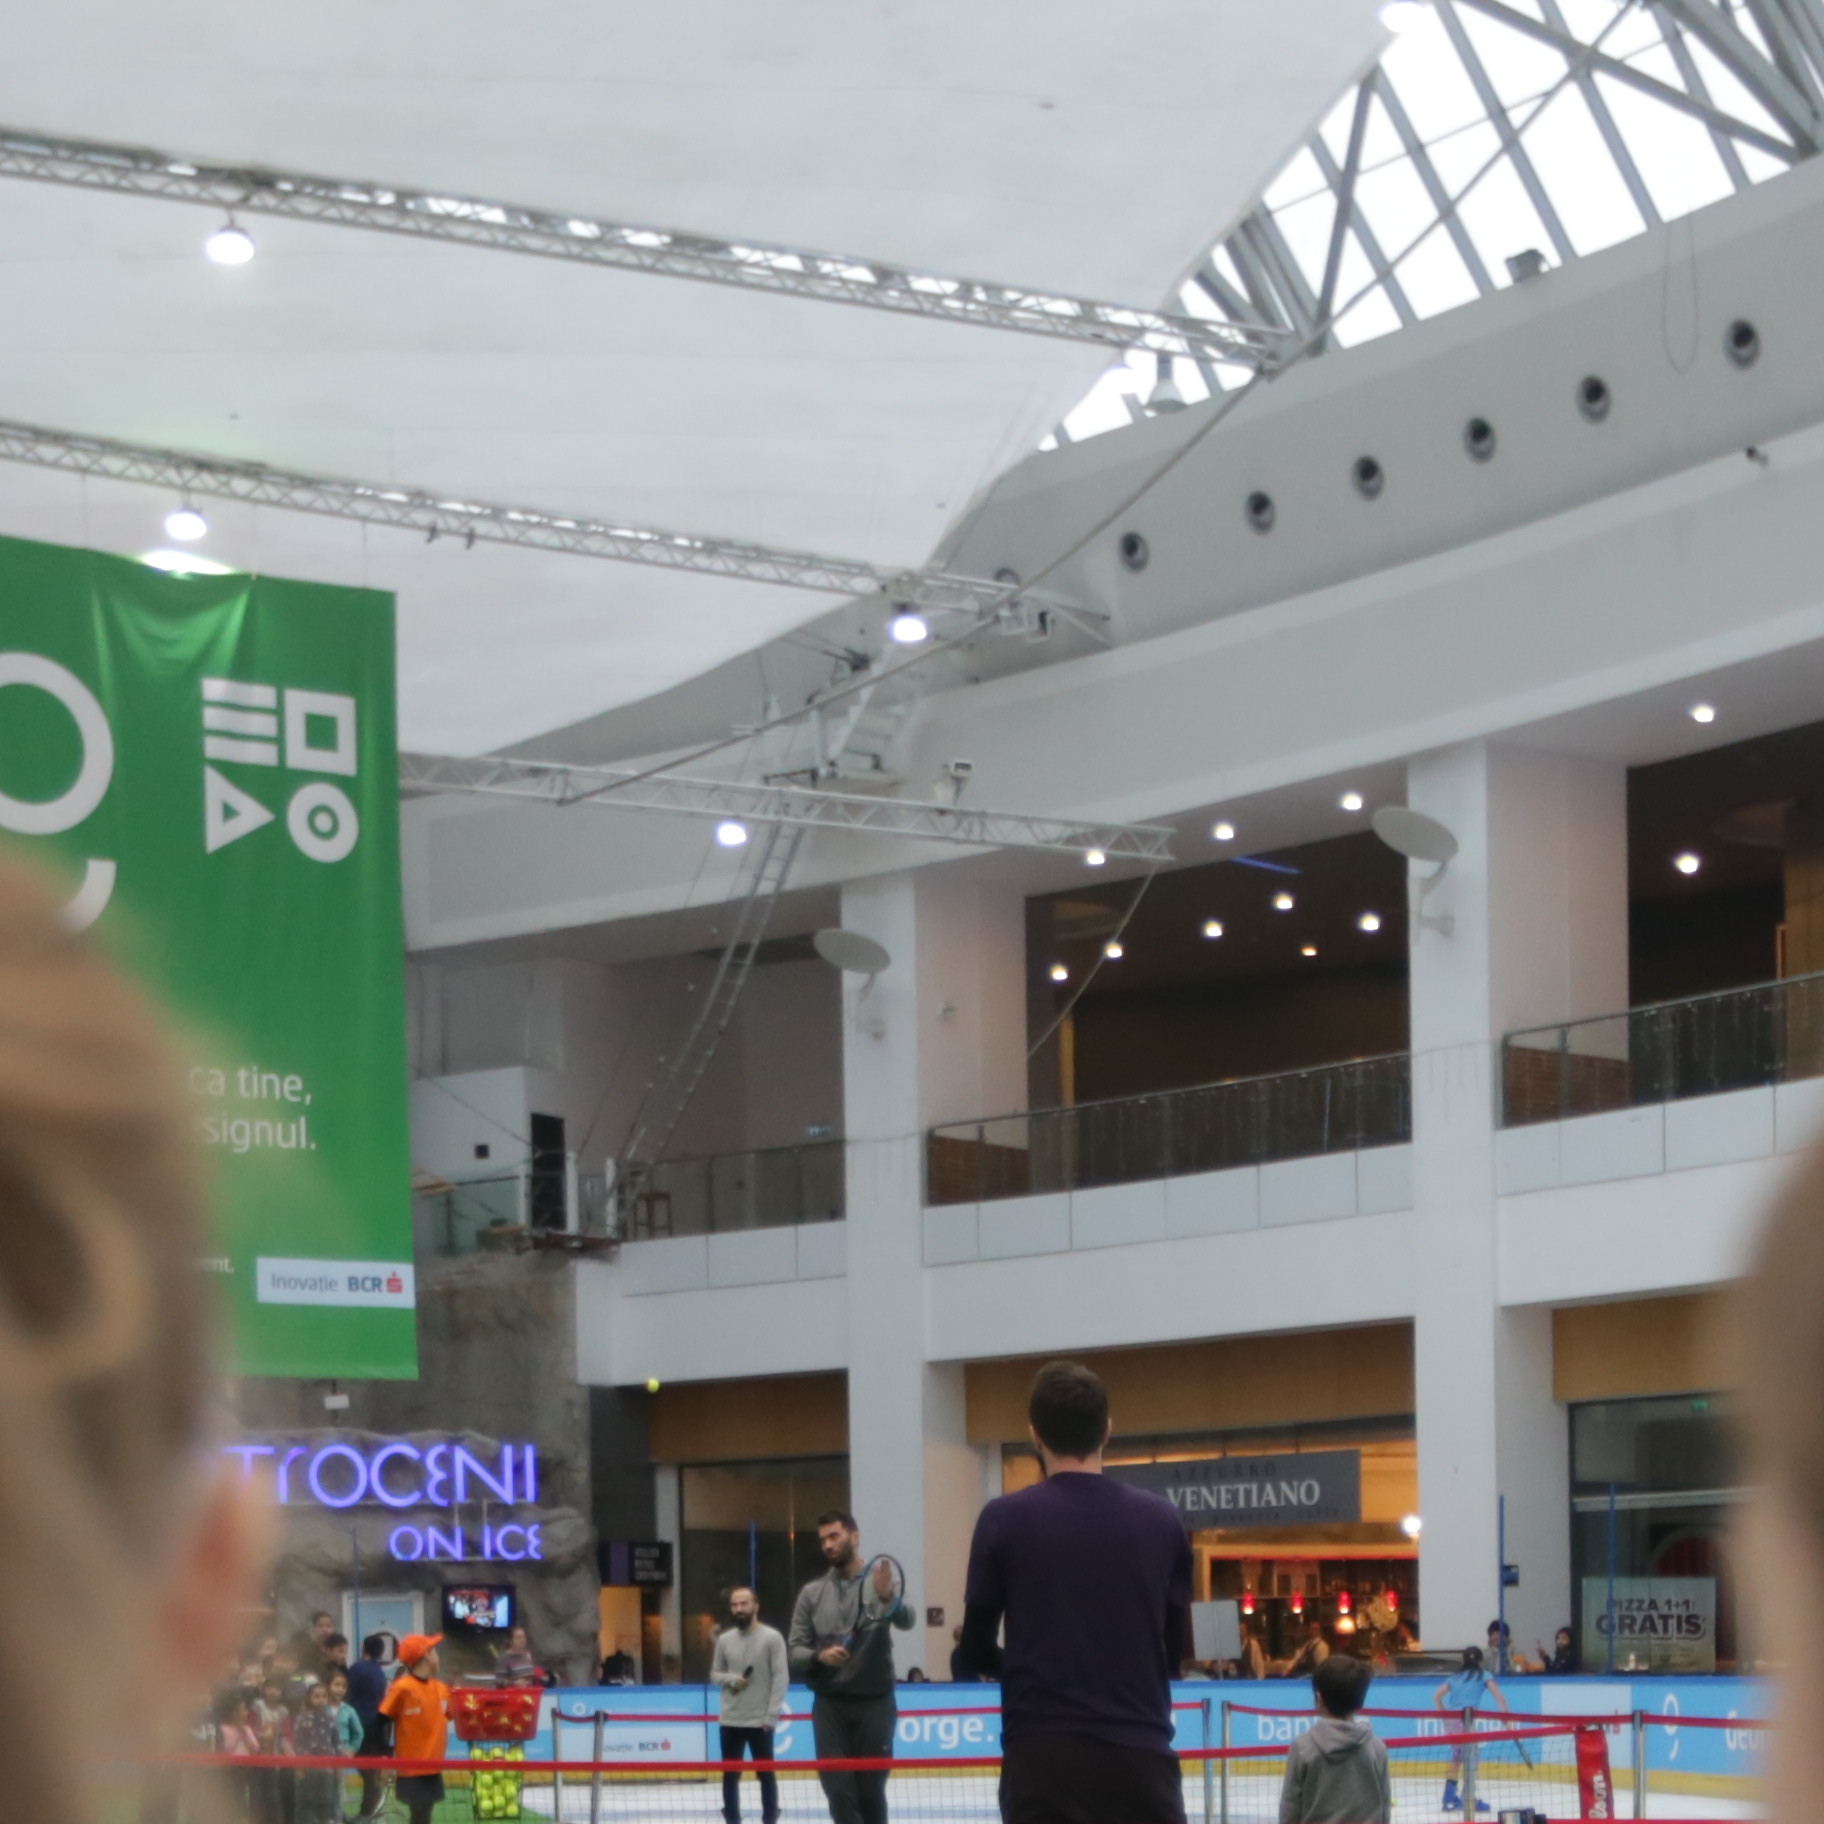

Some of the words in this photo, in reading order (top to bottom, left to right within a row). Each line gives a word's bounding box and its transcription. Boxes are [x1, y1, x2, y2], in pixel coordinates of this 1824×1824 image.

[237, 1066, 312, 1106] tine,
[203, 1114, 317, 1154] signul.
[347, 1276, 383, 1293] BCR
[222, 1443, 539, 1508] TROCENI
[1166, 1478, 1322, 1512] VENETIANO
[388, 1524, 466, 1562] ON
[481, 1523, 545, 1561] ICE
[898, 1715, 995, 1750] orge.
